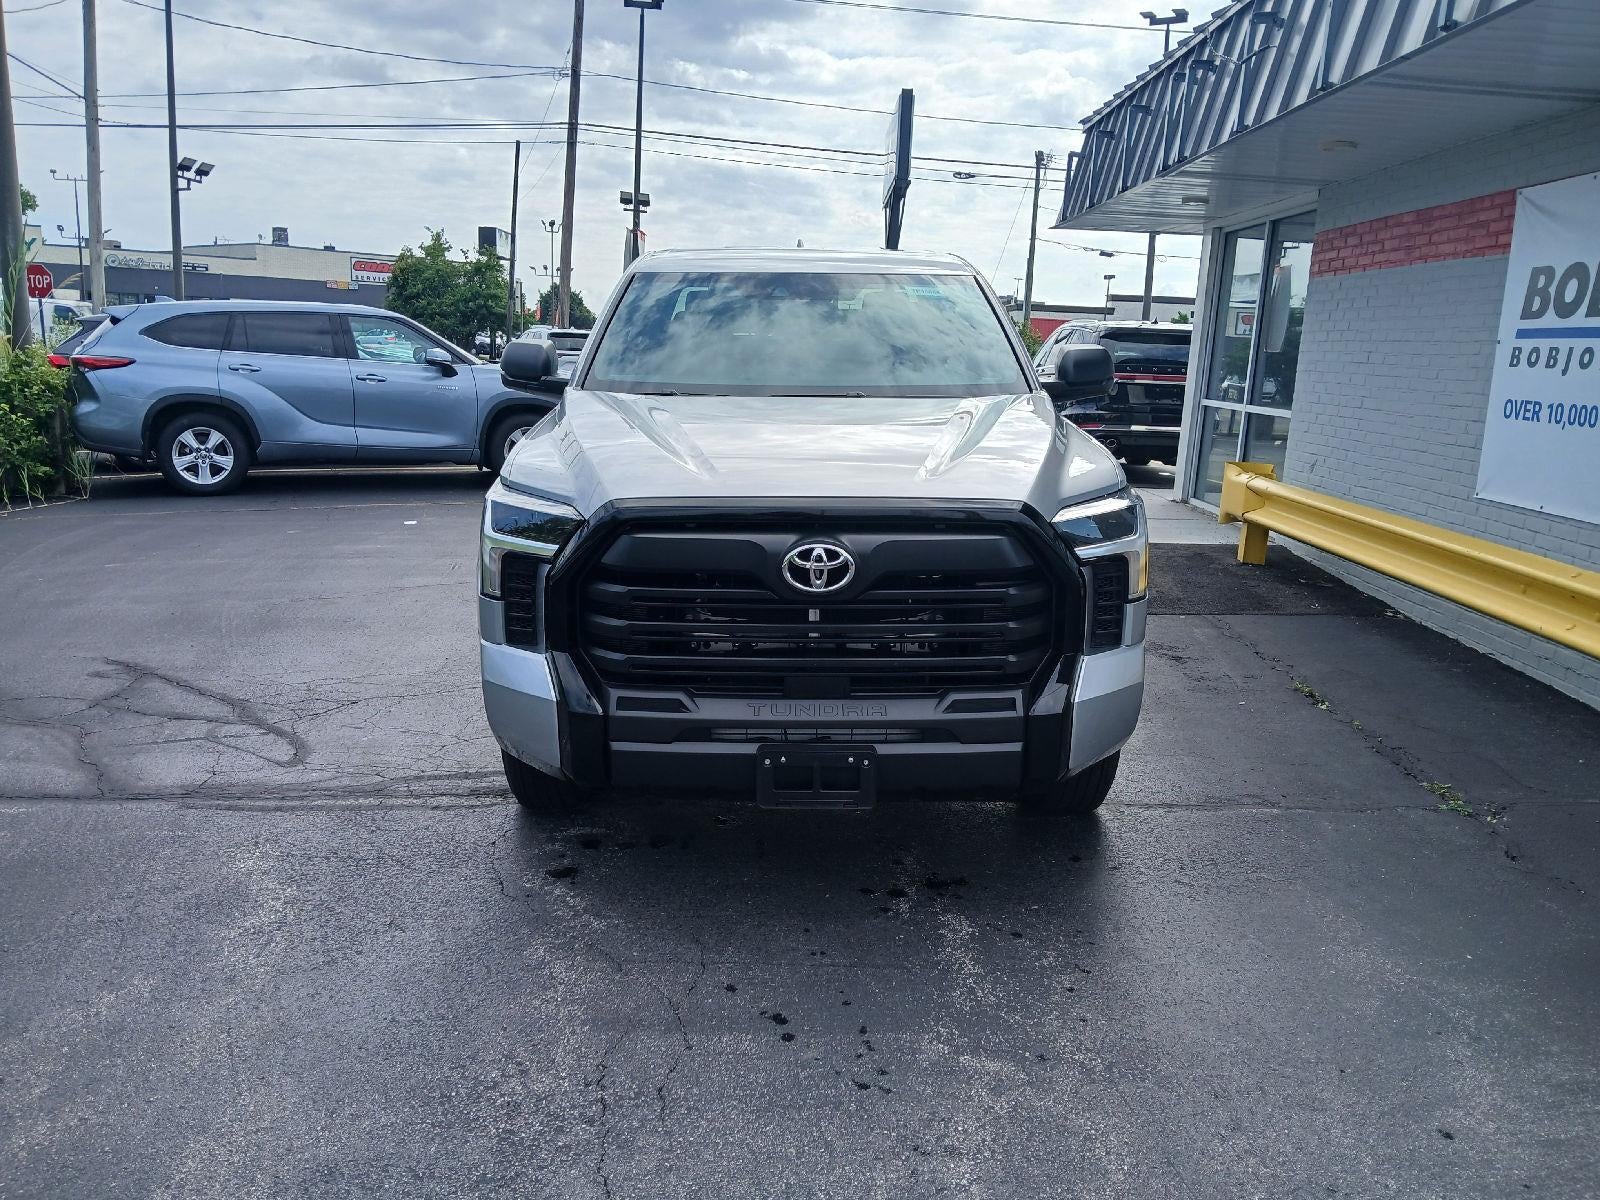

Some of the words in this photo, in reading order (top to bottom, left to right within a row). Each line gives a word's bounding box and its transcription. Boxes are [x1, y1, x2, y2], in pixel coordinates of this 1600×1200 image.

[27, 274, 51, 288] TOP
[1503, 399, 1542, 423] OVER
[1547, 402, 1599, 430] 10,000
[747, 703, 888, 717] TUNDRA
